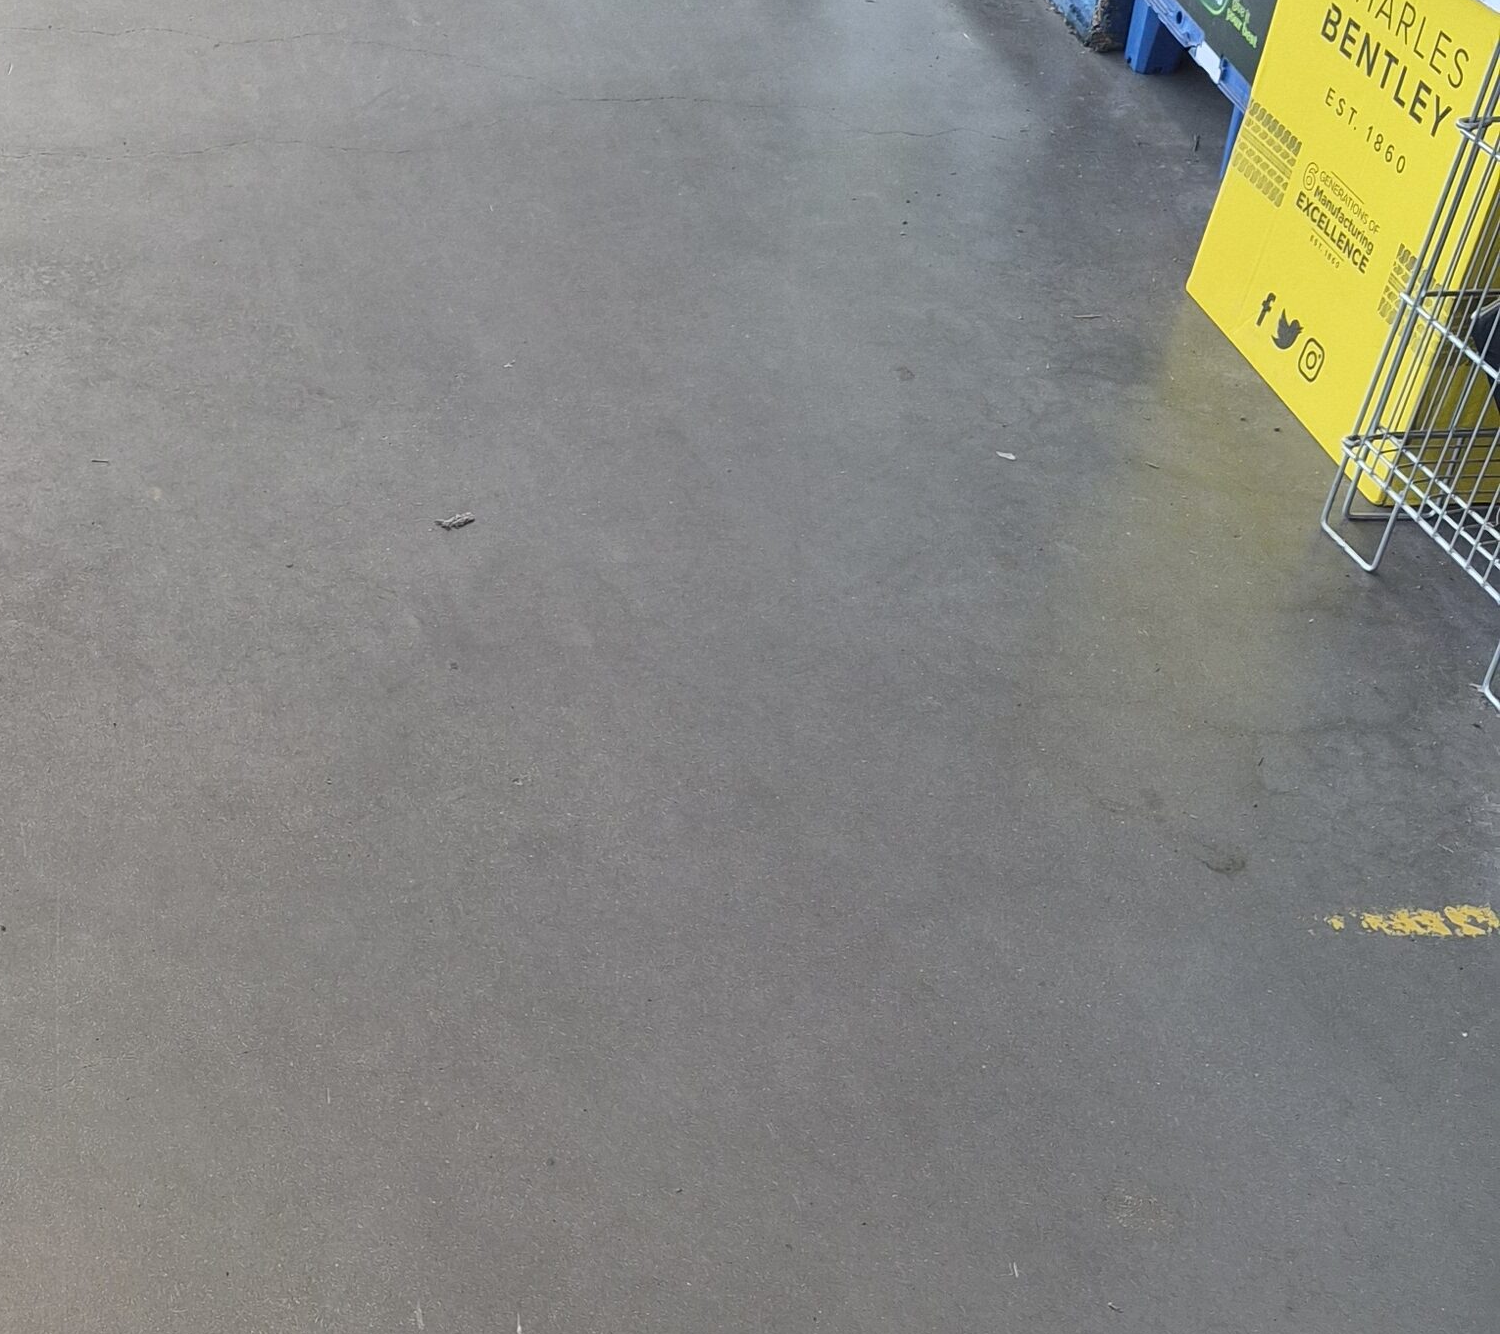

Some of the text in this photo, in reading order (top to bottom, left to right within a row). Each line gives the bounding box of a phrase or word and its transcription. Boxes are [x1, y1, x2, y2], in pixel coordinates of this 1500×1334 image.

[1321, 2, 1453, 138] BENTLEY
[1325, 87, 1407, 174] EST. 1860
[1296, 191, 1370, 275] EXCELLENCE
[1303, 162, 1380, 235] 6 GENERATIONS OF
[1313, 185, 1374, 256] Manufacturing
